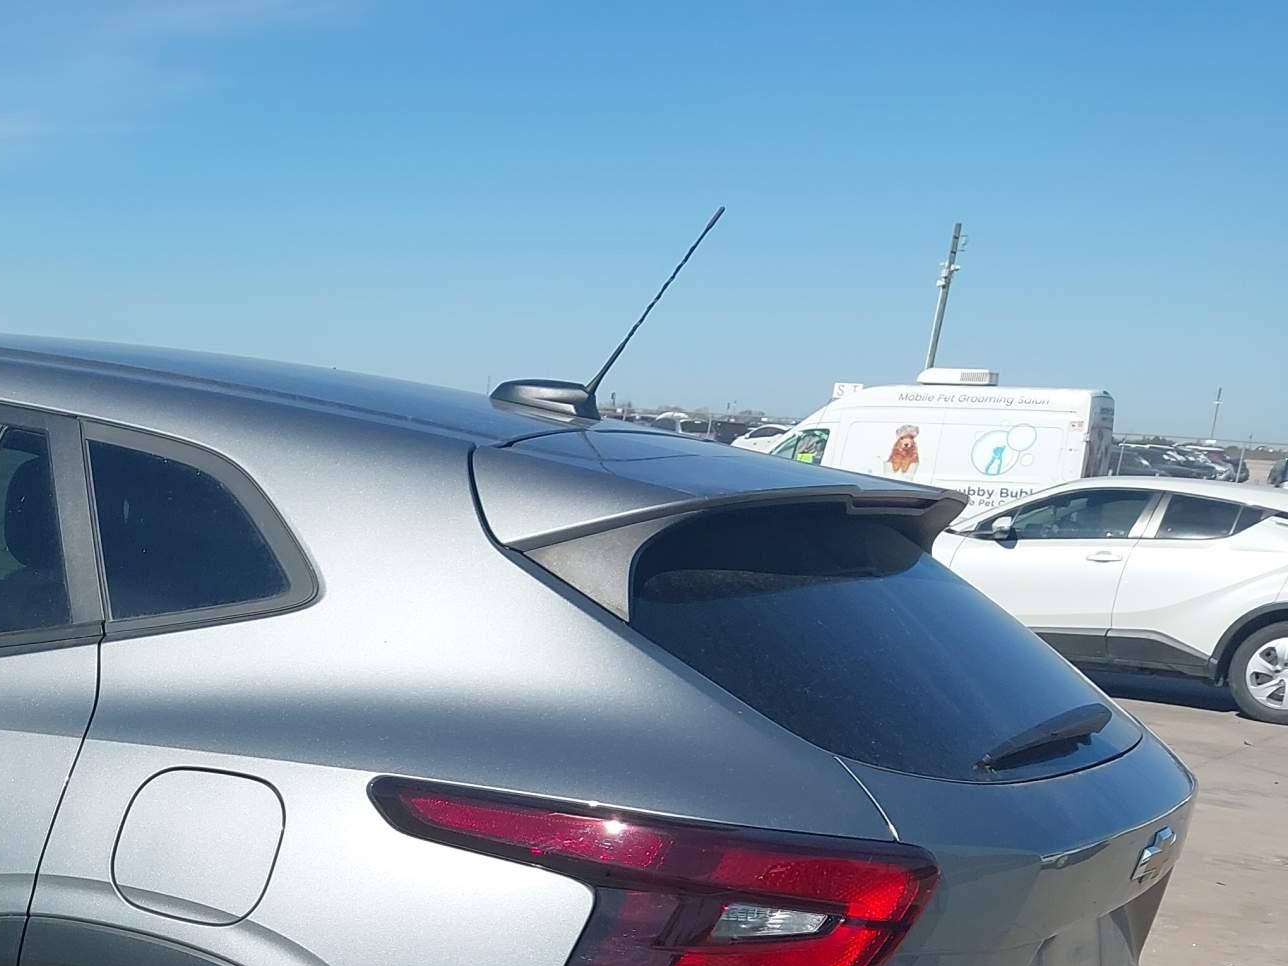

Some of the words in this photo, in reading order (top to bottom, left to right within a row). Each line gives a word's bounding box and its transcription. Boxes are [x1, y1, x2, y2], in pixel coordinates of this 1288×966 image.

[837, 384, 845, 396] S
[897, 392, 934, 402] Mobile
[936, 394, 955, 403] Pet
[958, 394, 1014, 406] Grooming
[1017, 395, 1049, 405] Salon
